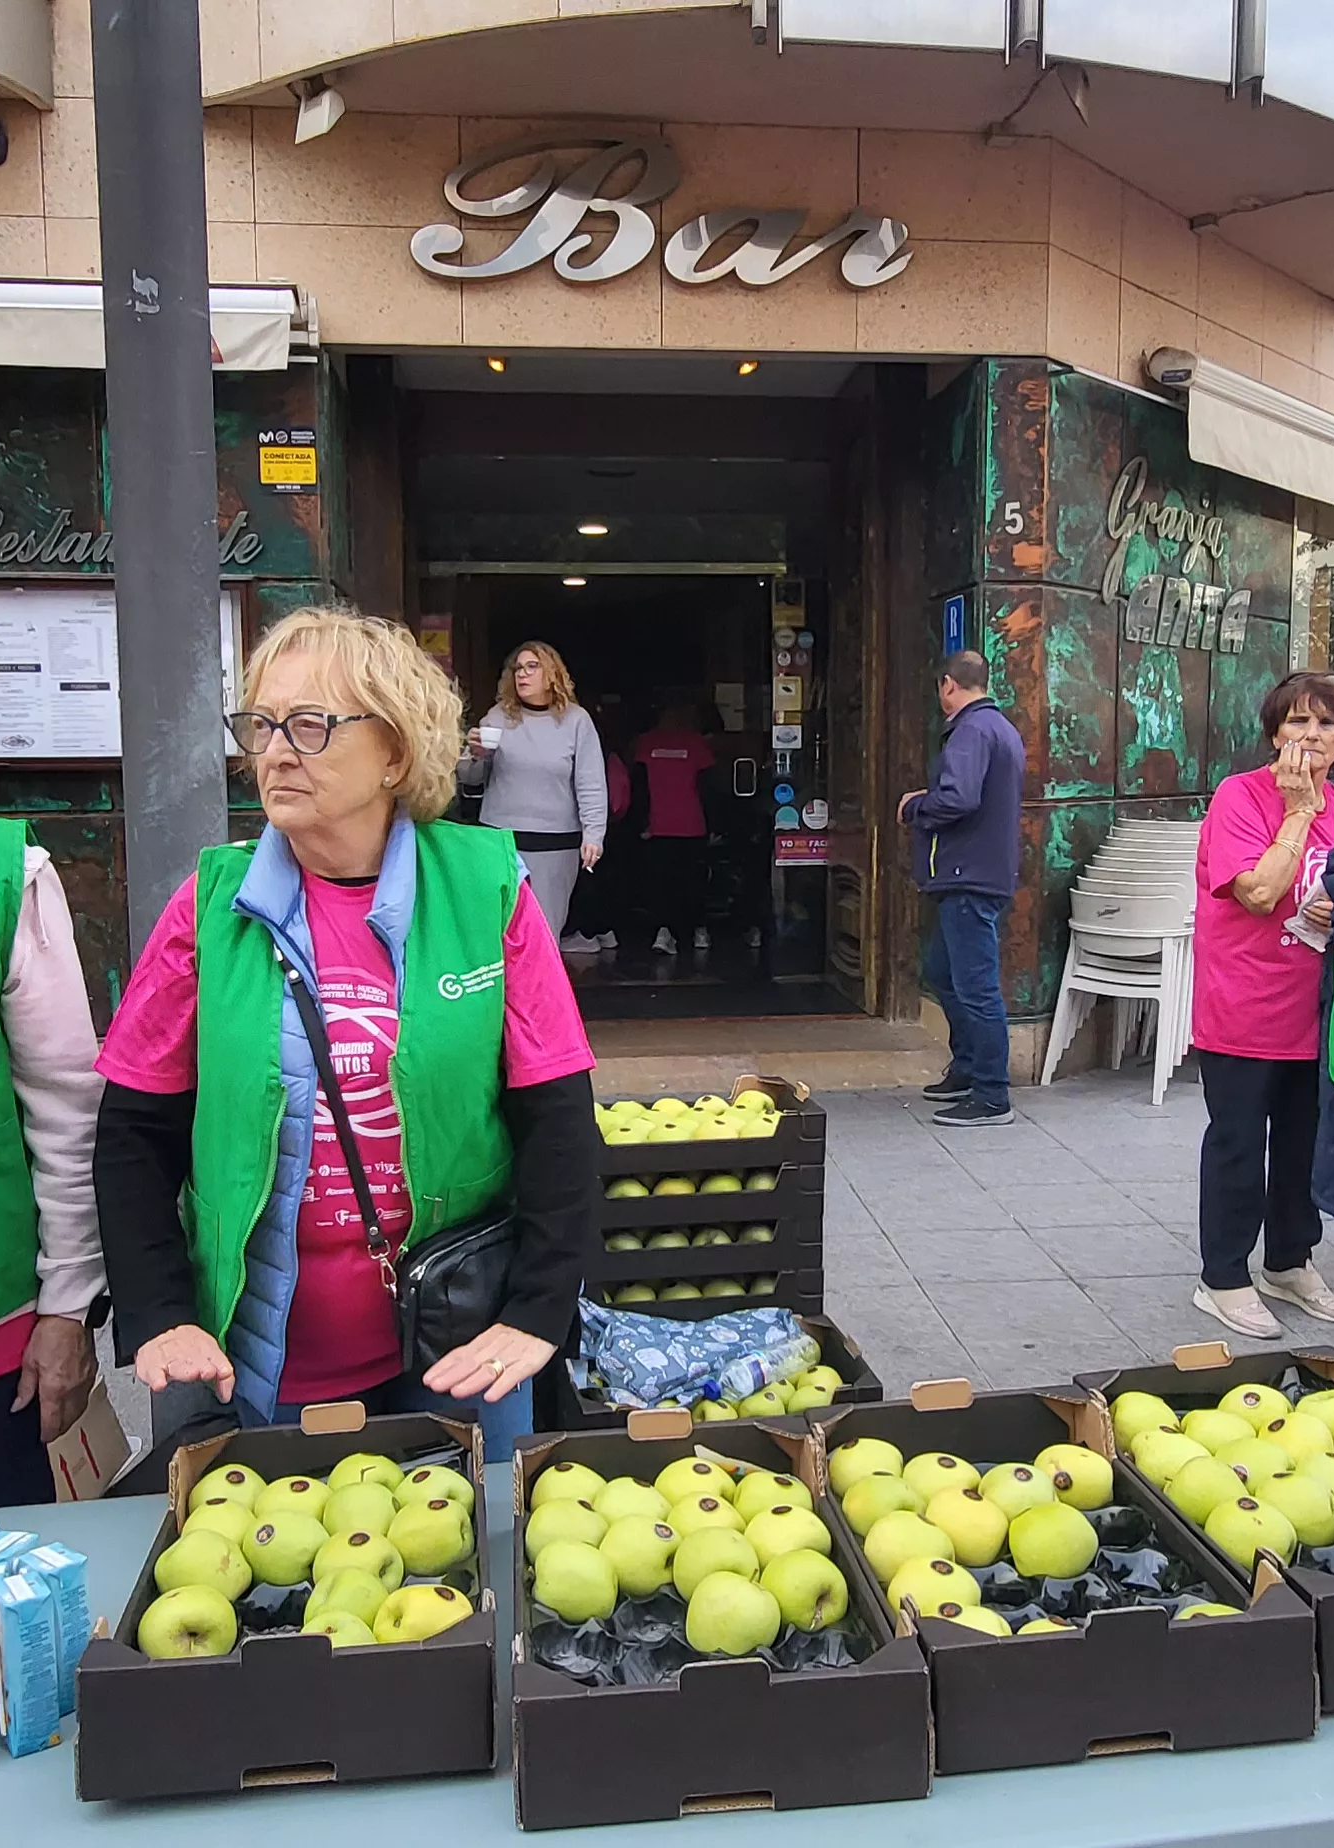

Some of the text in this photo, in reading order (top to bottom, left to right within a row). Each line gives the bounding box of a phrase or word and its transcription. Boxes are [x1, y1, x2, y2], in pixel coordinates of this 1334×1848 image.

[410, 134, 914, 287] Bar
[263, 452, 312, 460] CONECTADA
[1004, 500, 1024, 535] 5
[1103, 456, 1225, 605] Granja
[949, 605, 958, 638] R
[331, 1041, 374, 1055] inemos
[331, 1056, 371, 1074] NTOS
